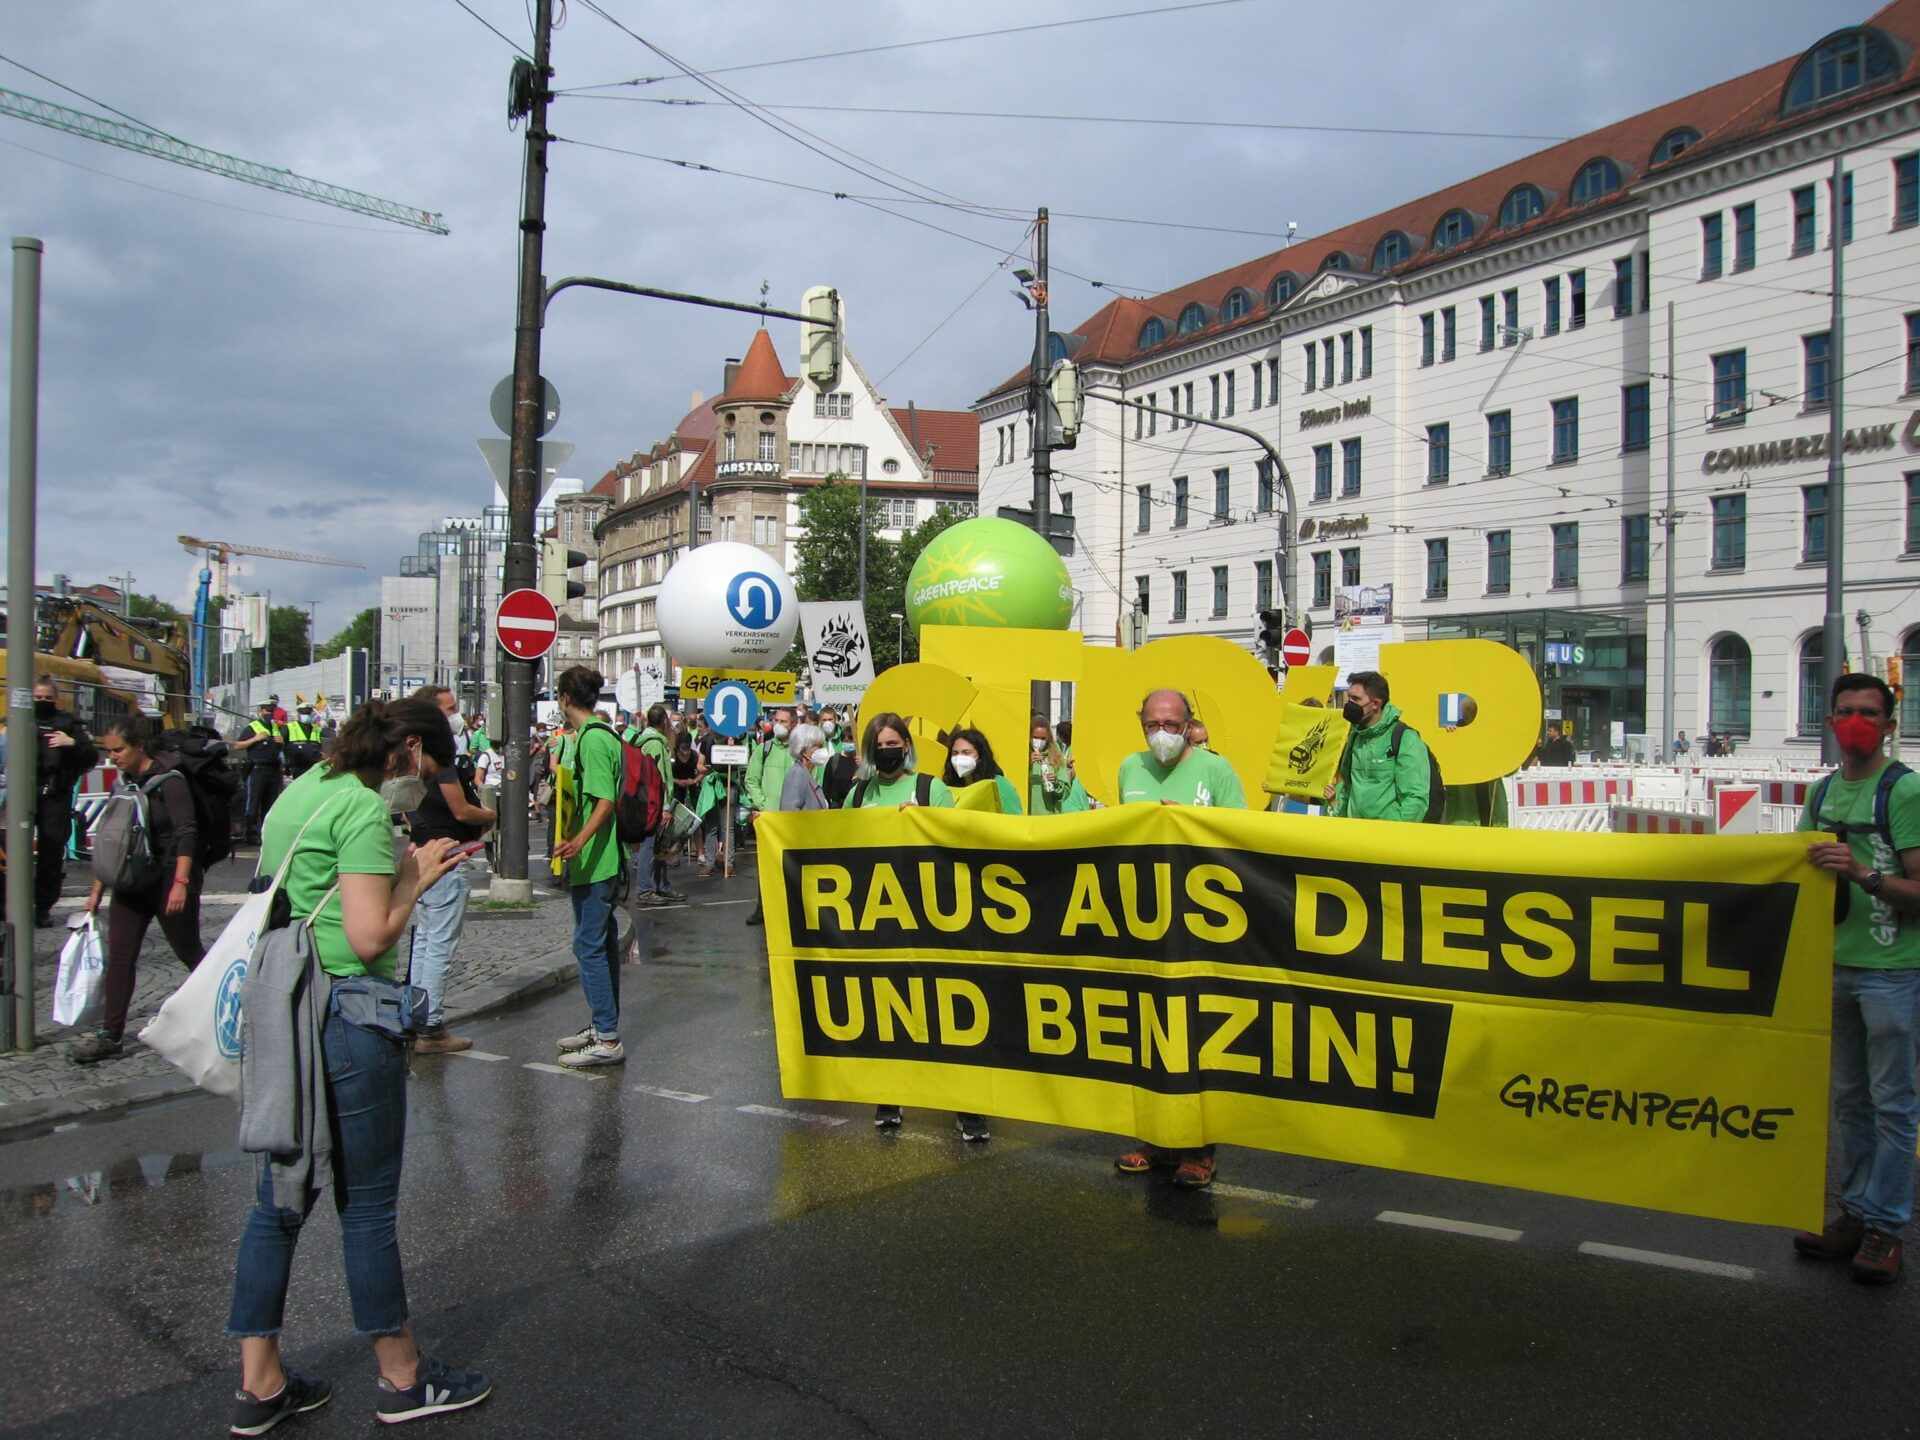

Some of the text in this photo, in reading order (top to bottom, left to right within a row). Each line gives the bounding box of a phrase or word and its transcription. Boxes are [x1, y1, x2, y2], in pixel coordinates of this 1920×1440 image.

[717, 462, 780, 474] KARSTADT
[1702, 423, 1896, 473] COMMERZANK
[913, 575, 1004, 606] GREENPEACE
[725, 630, 780, 638] VERKEHRSWENDE
[1561, 646, 1584, 663] U S
[801, 861, 1750, 990] RAUS AUS DIESEL
[811, 976, 1414, 1095] UND BENZIN!
[1500, 1073, 1793, 1140] GREENPEACE
